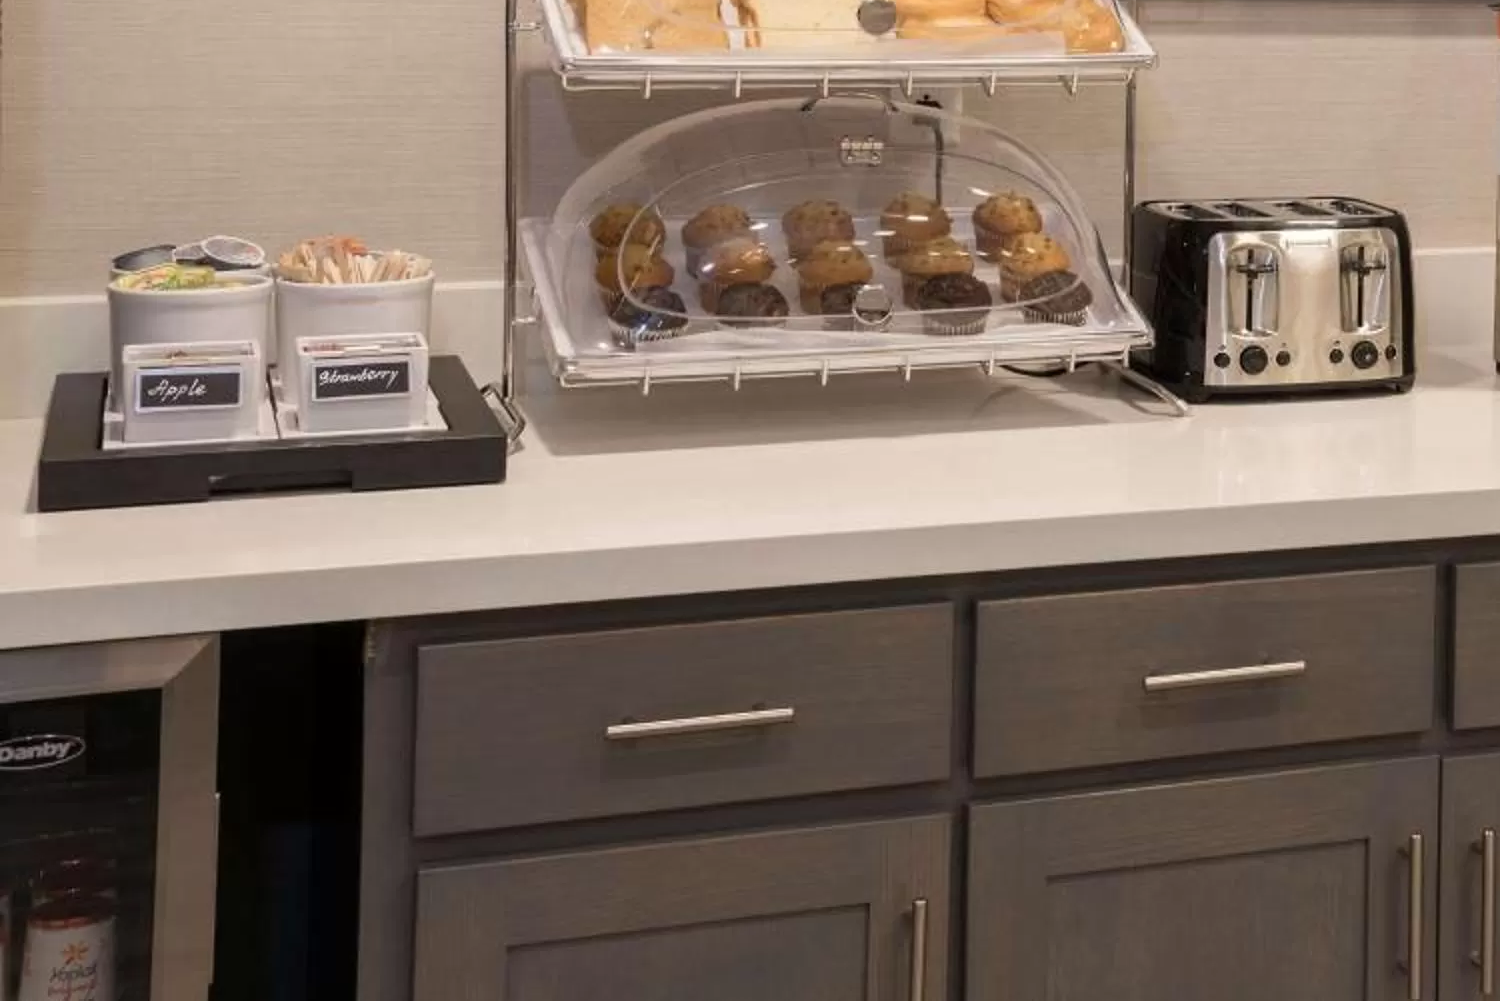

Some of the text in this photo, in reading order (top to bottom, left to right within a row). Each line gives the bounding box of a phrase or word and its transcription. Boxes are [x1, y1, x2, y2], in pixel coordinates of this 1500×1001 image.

[318, 367, 400, 388] Strawberry
[147, 378, 208, 401] Apple
[0, 741, 71, 762] Danby
